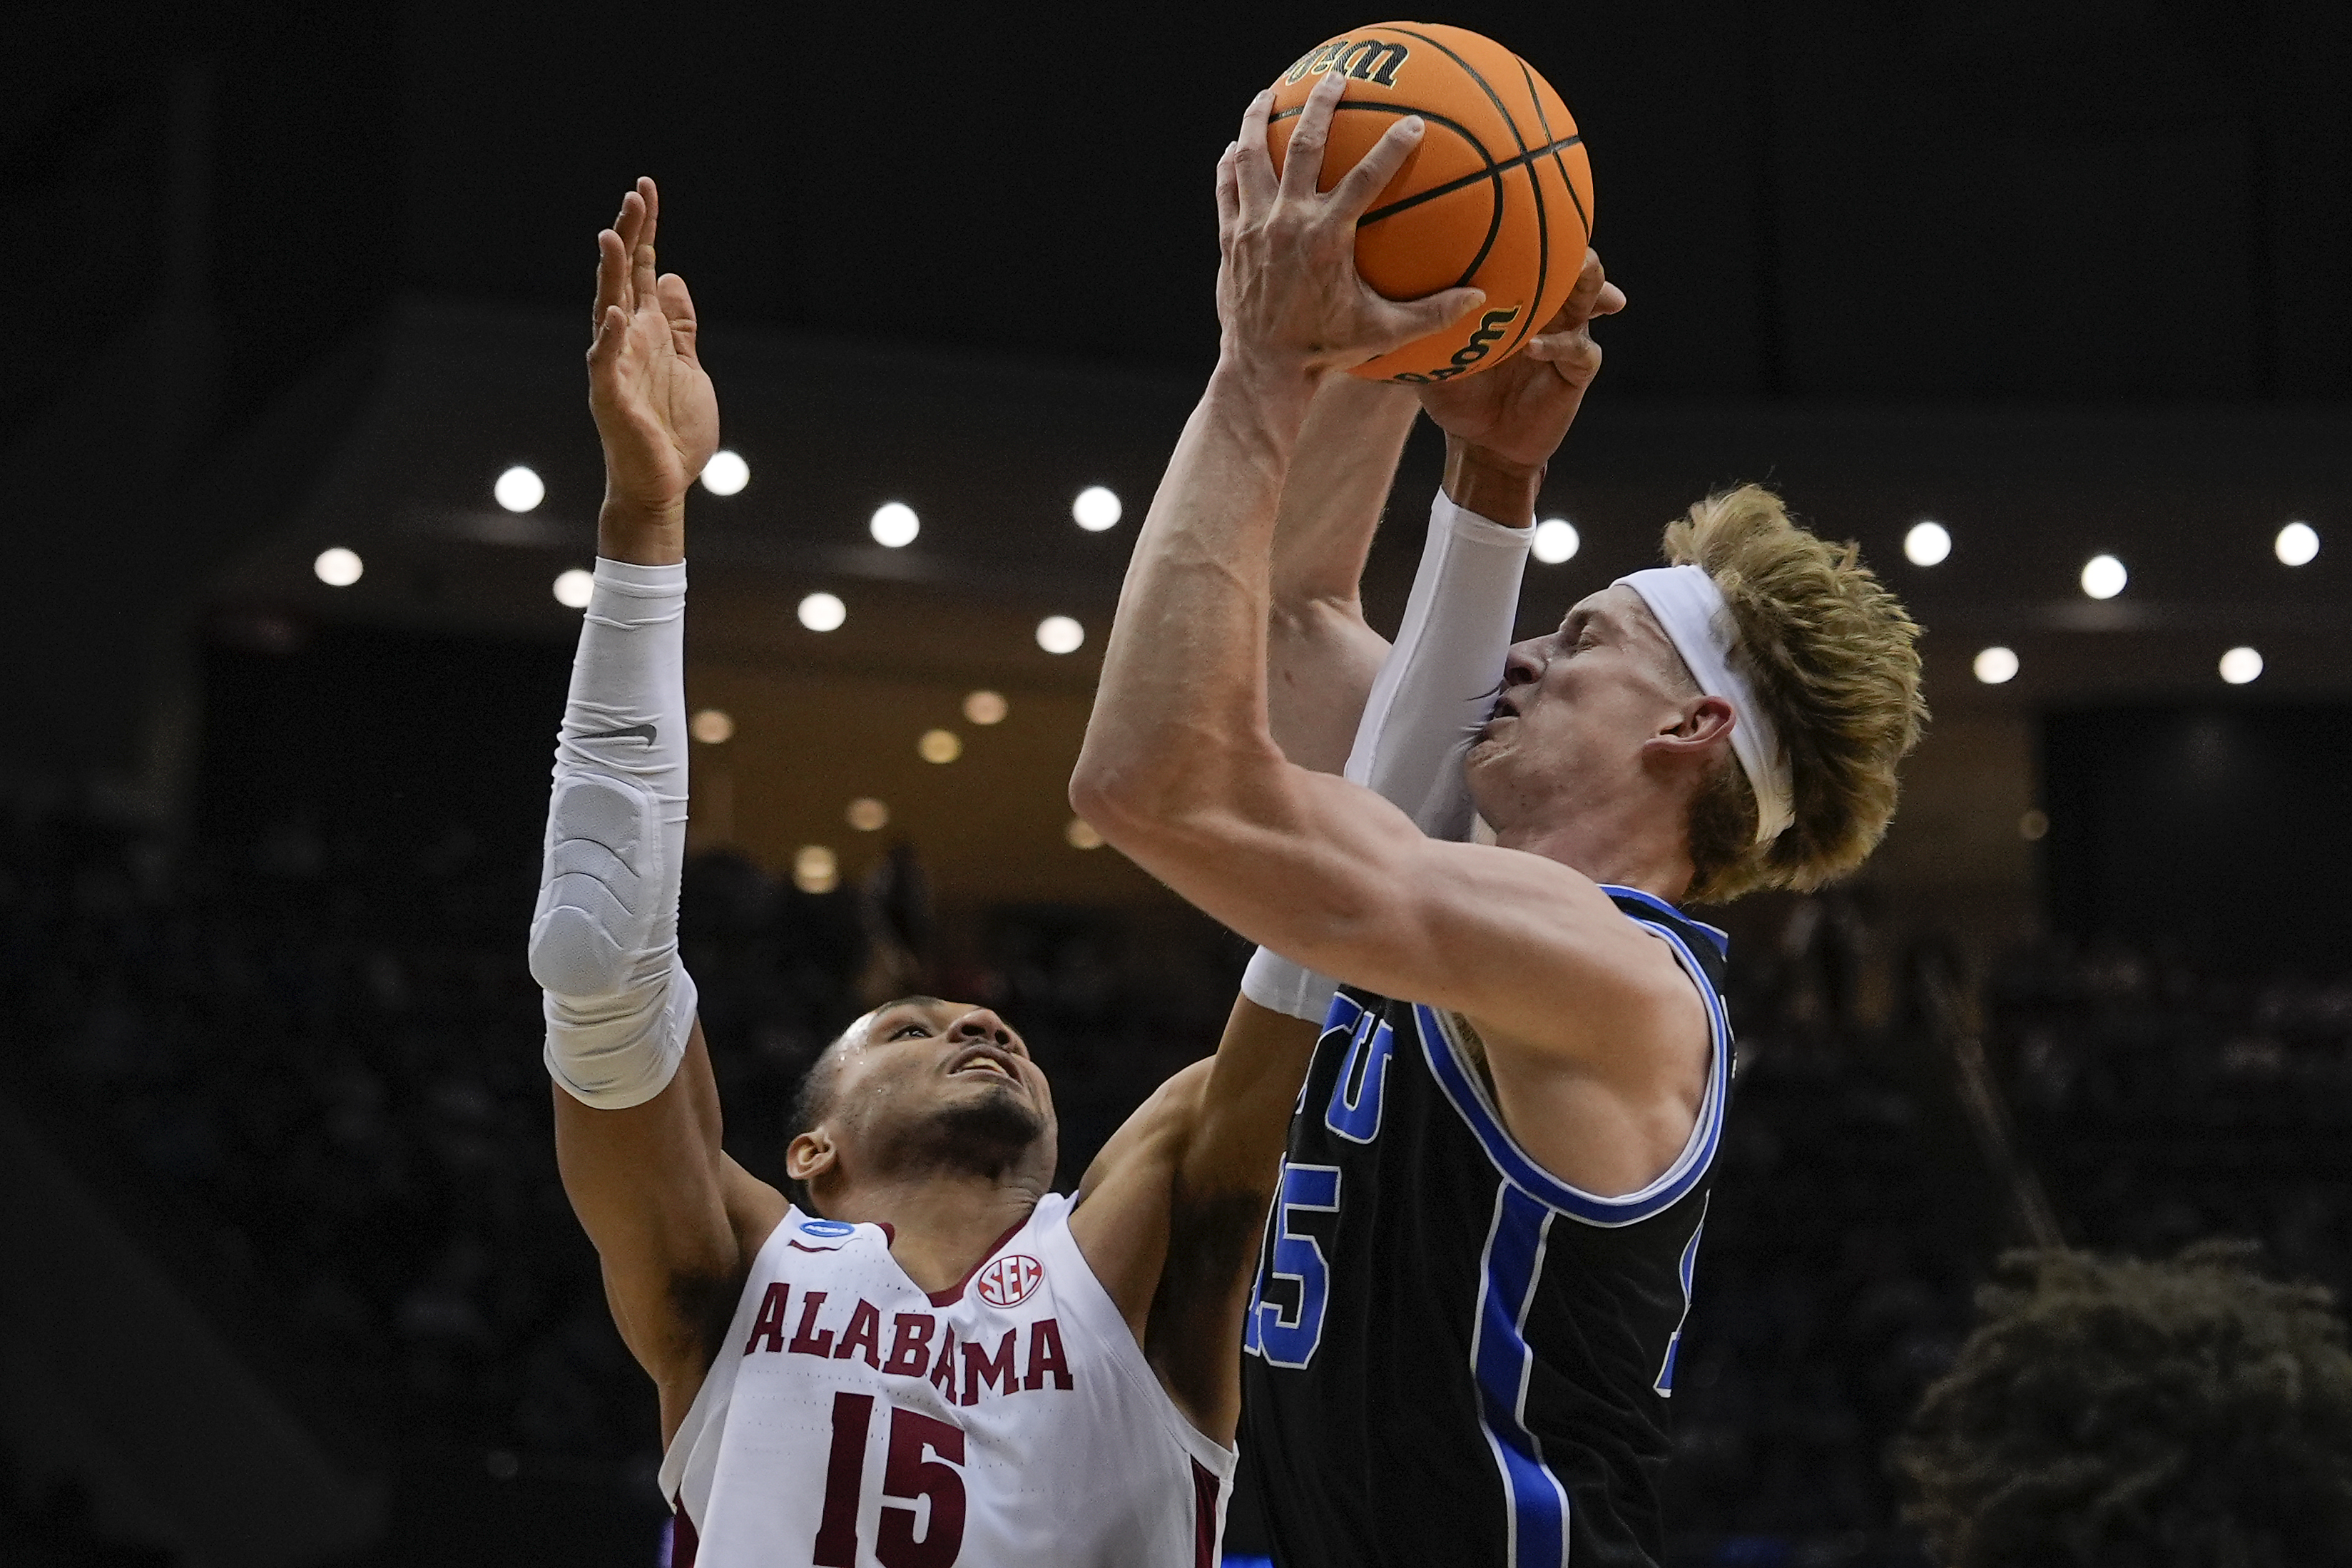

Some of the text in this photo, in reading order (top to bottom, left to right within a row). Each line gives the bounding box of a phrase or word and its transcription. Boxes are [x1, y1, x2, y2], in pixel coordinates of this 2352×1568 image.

[980, 1256, 1039, 1305] SEC
[744, 1282, 1074, 1407] ALABAMA
[812, 1391, 967, 1568] 15
